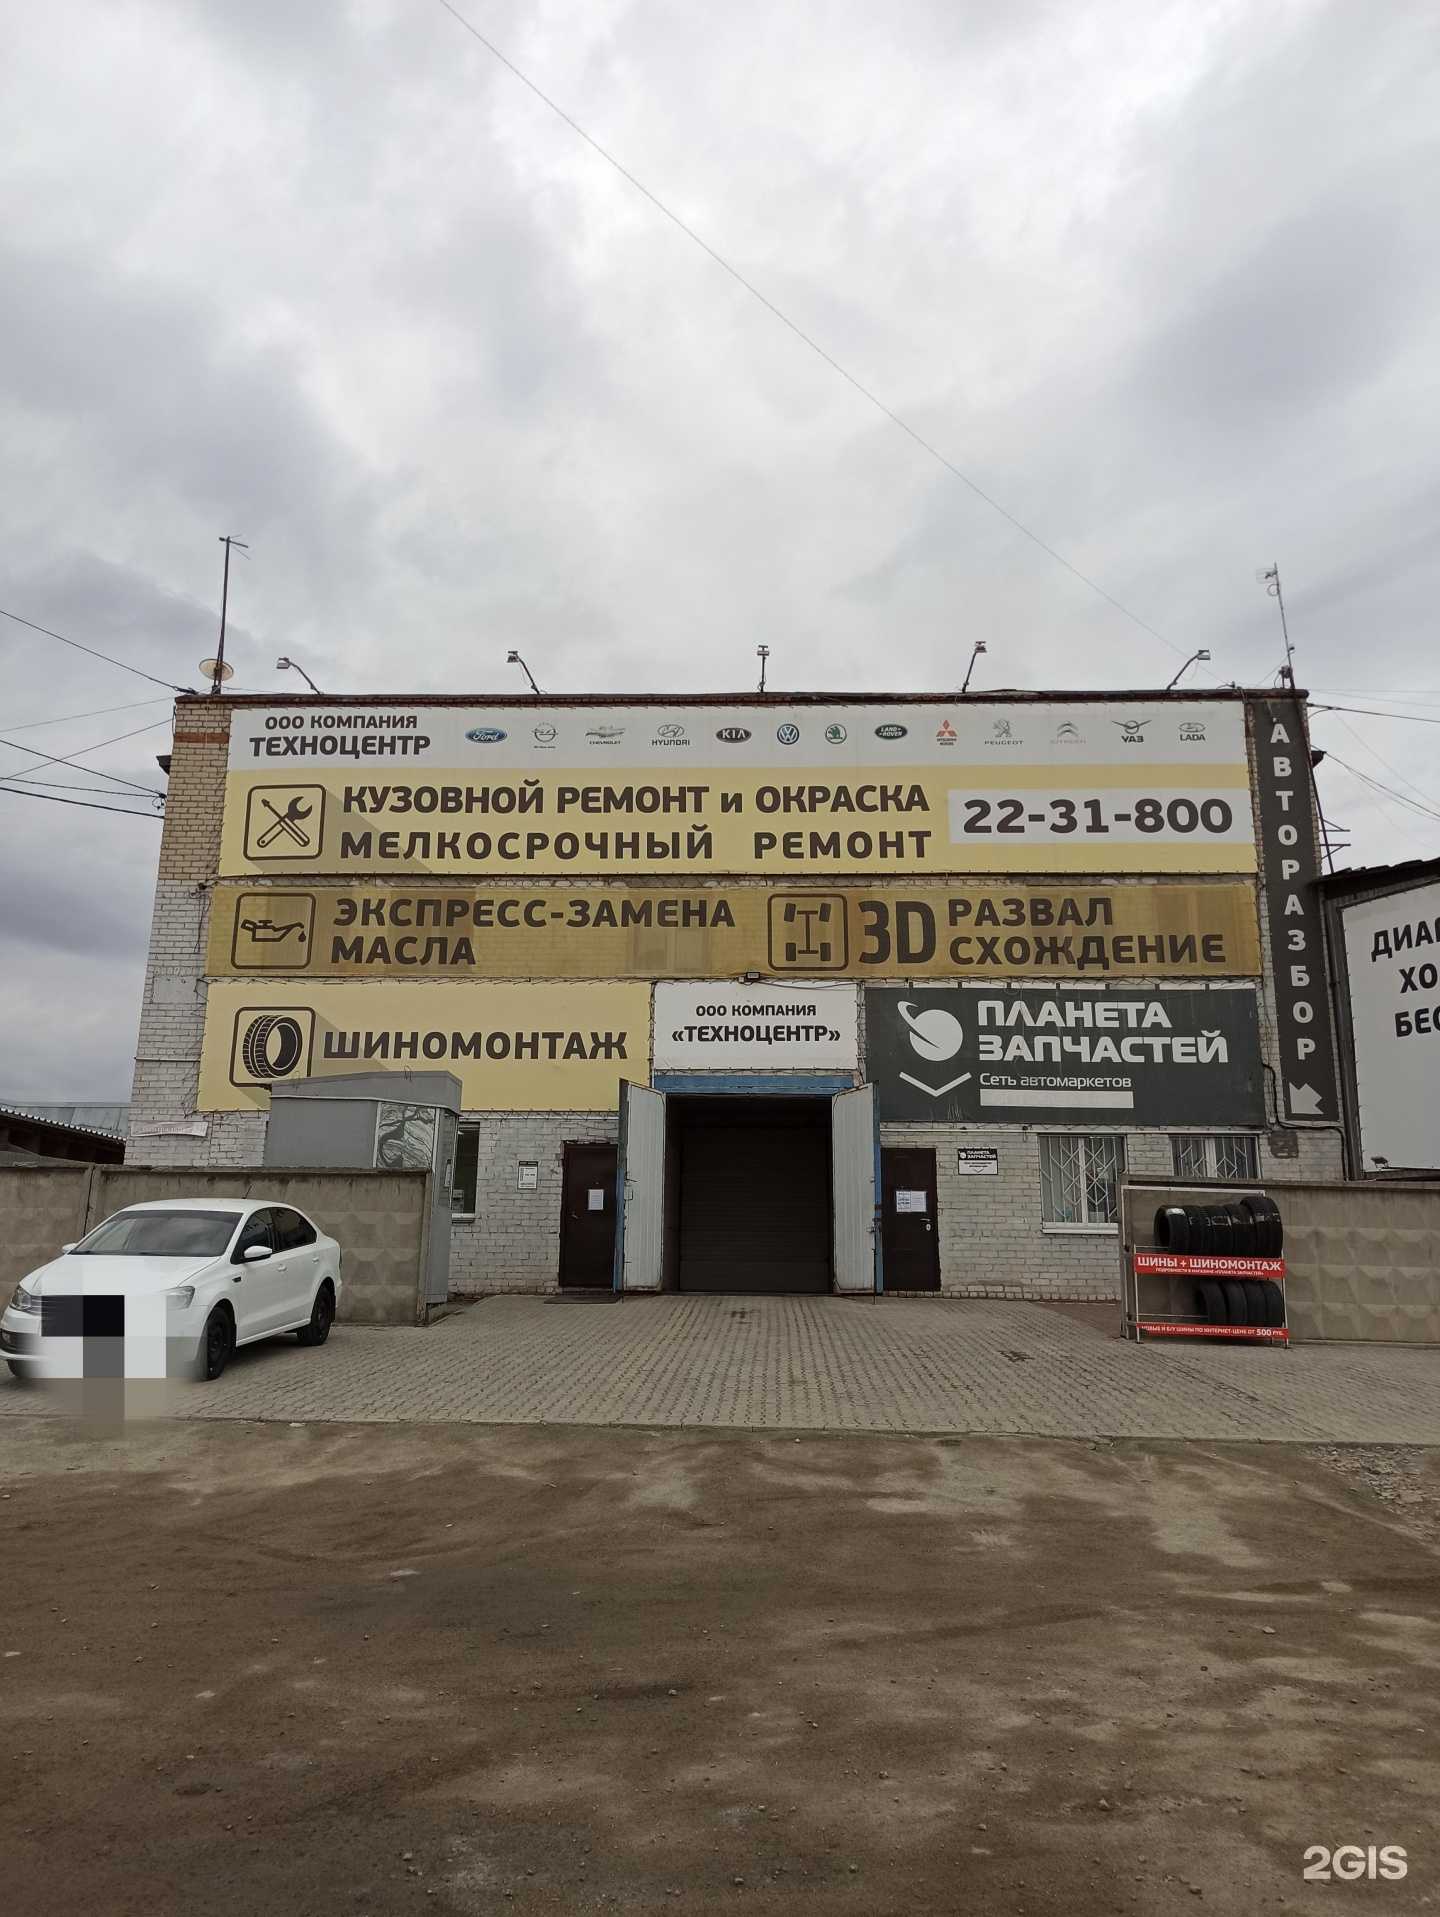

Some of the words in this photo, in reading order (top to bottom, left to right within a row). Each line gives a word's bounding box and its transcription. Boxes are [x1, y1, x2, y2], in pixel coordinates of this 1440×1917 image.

[265, 716, 304, 730] ООО
[310, 715, 418, 730] КОМПАНИЯ
[722, 730, 746, 740] KIA
[250, 735, 431, 759] ТЕХНОЦЕНТР
[1121, 735, 1144, 743] УАЗ
[1179, 734, 1206, 742] LADA
[342, 779, 544, 815] КУЗОВНОЙ
[557, 785, 710, 814] РЕМОНТ
[755, 785, 930, 814] ОКРАСКА
[963, 798, 1233, 834] 22-31-800
[340, 823, 713, 860] МЕЛКОСРОЧНЫЙ
[754, 831, 932, 860] РЕМОНТ
[1270, 723, 1317, 1061] АВТОРАЗБОР
[333, 897, 736, 928] ЭКСПРЕСС-ЗАМЕНА
[948, 898, 1113, 928] РАЗВАЛ
[859, 901, 936, 965] 3D
[331, 936, 477, 965] МАСЛА
[948, 934, 1227, 970] СХОЖДЕНИЕ
[695, 1005, 728, 1017] ООО
[731, 1004, 817, 1017] КОМПАНИЯ
[977, 1001, 1172, 1029] ПЛАНЕТА
[323, 1031, 628, 1060] ШИНОМОНТАЖ
[671, 1024, 841, 1046] «ТЕХНОЦЕНТР»
[977, 1031, 1229, 1064] ЗАПЧАСТЕЙ
[979, 1073, 1017, 1088] Сеть
[1020, 1074, 1132, 1091] автомаркетов
[1137, 1256, 1178, 1267] ШИНЫ
[1190, 1258, 1281, 1271] ШИНОМОНТАЖ
[1256, 1328, 1272, 1336] 500
